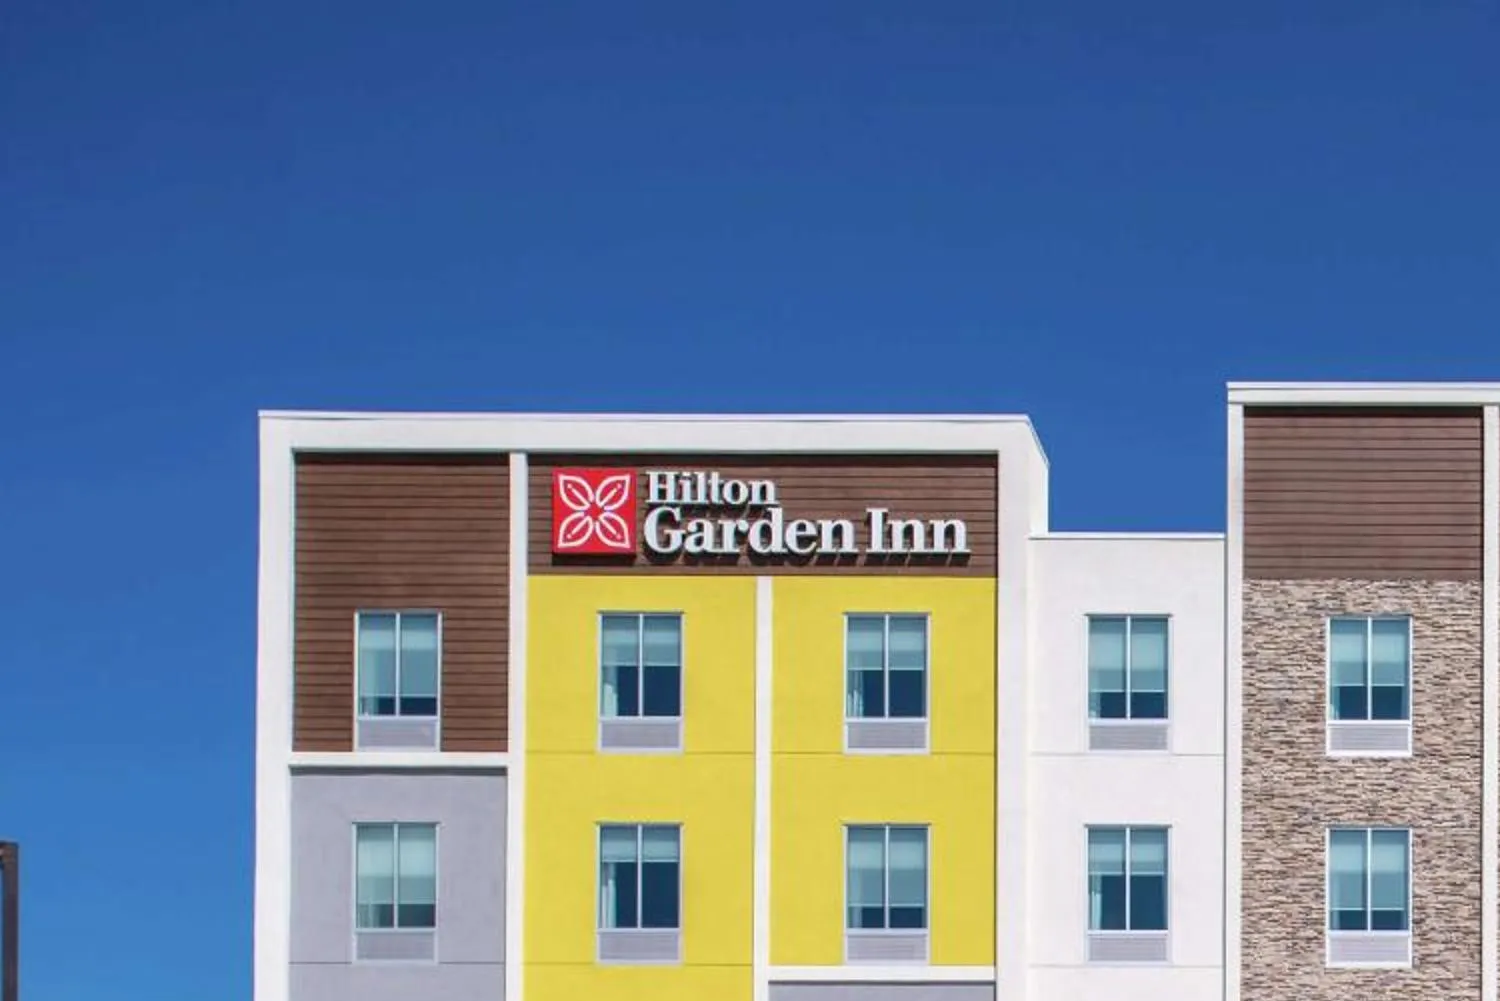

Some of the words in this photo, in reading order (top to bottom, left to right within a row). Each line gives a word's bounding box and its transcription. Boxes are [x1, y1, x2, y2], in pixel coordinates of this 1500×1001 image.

[645, 471, 780, 505] Hilton
[644, 506, 859, 553] Garden
[865, 507, 972, 553] Inn
